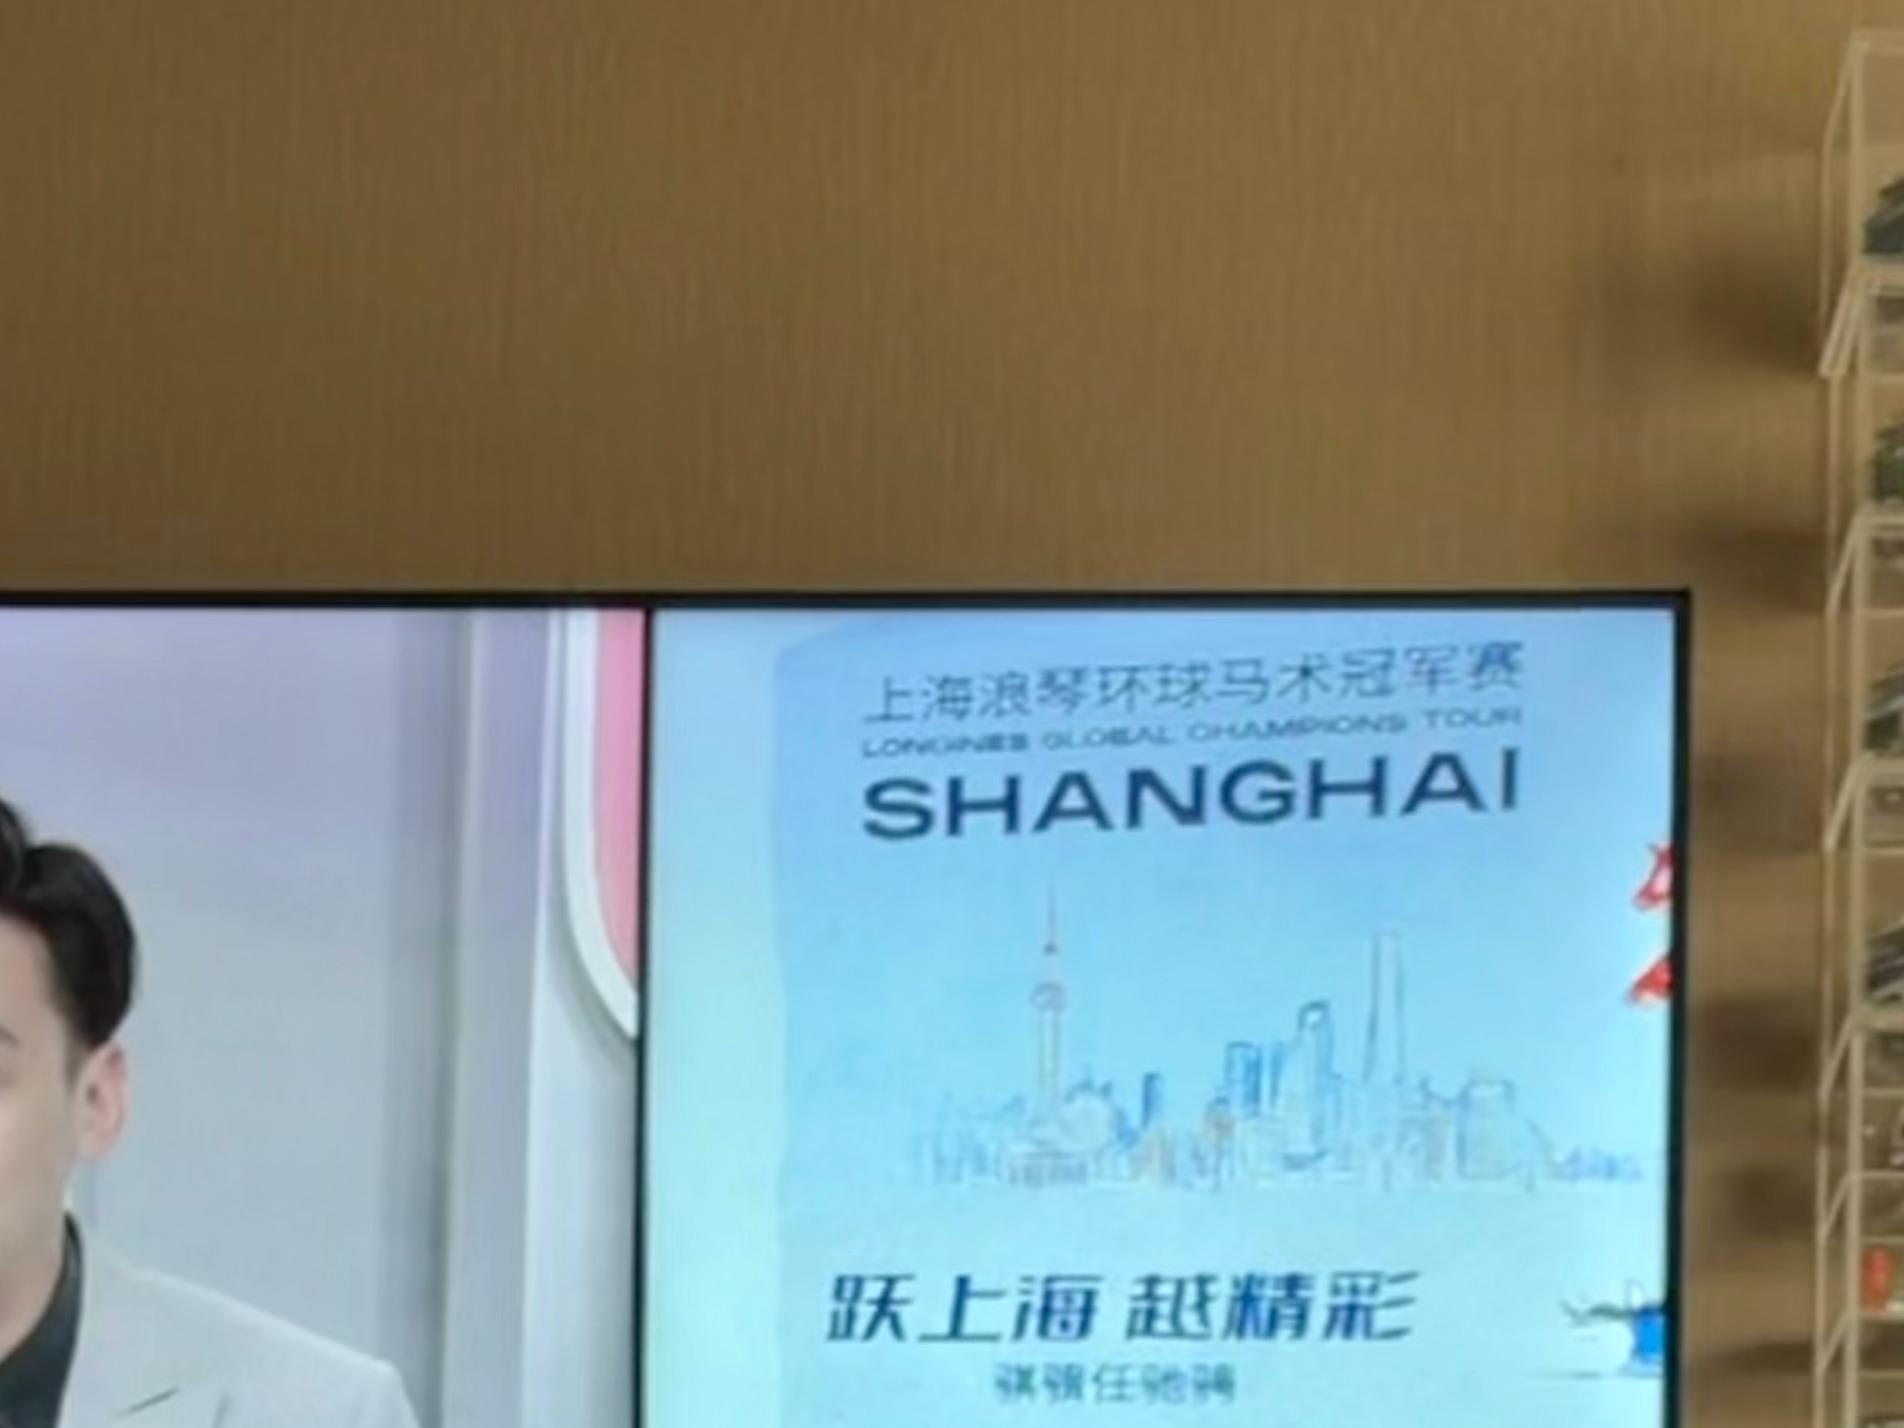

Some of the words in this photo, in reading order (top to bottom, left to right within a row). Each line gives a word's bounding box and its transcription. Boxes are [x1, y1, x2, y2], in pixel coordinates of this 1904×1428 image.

[862, 745, 1522, 842] SHANGHAI
[826, 1272, 1105, 1343] 跃上海
[1124, 1270, 1422, 1342] 越精彩
